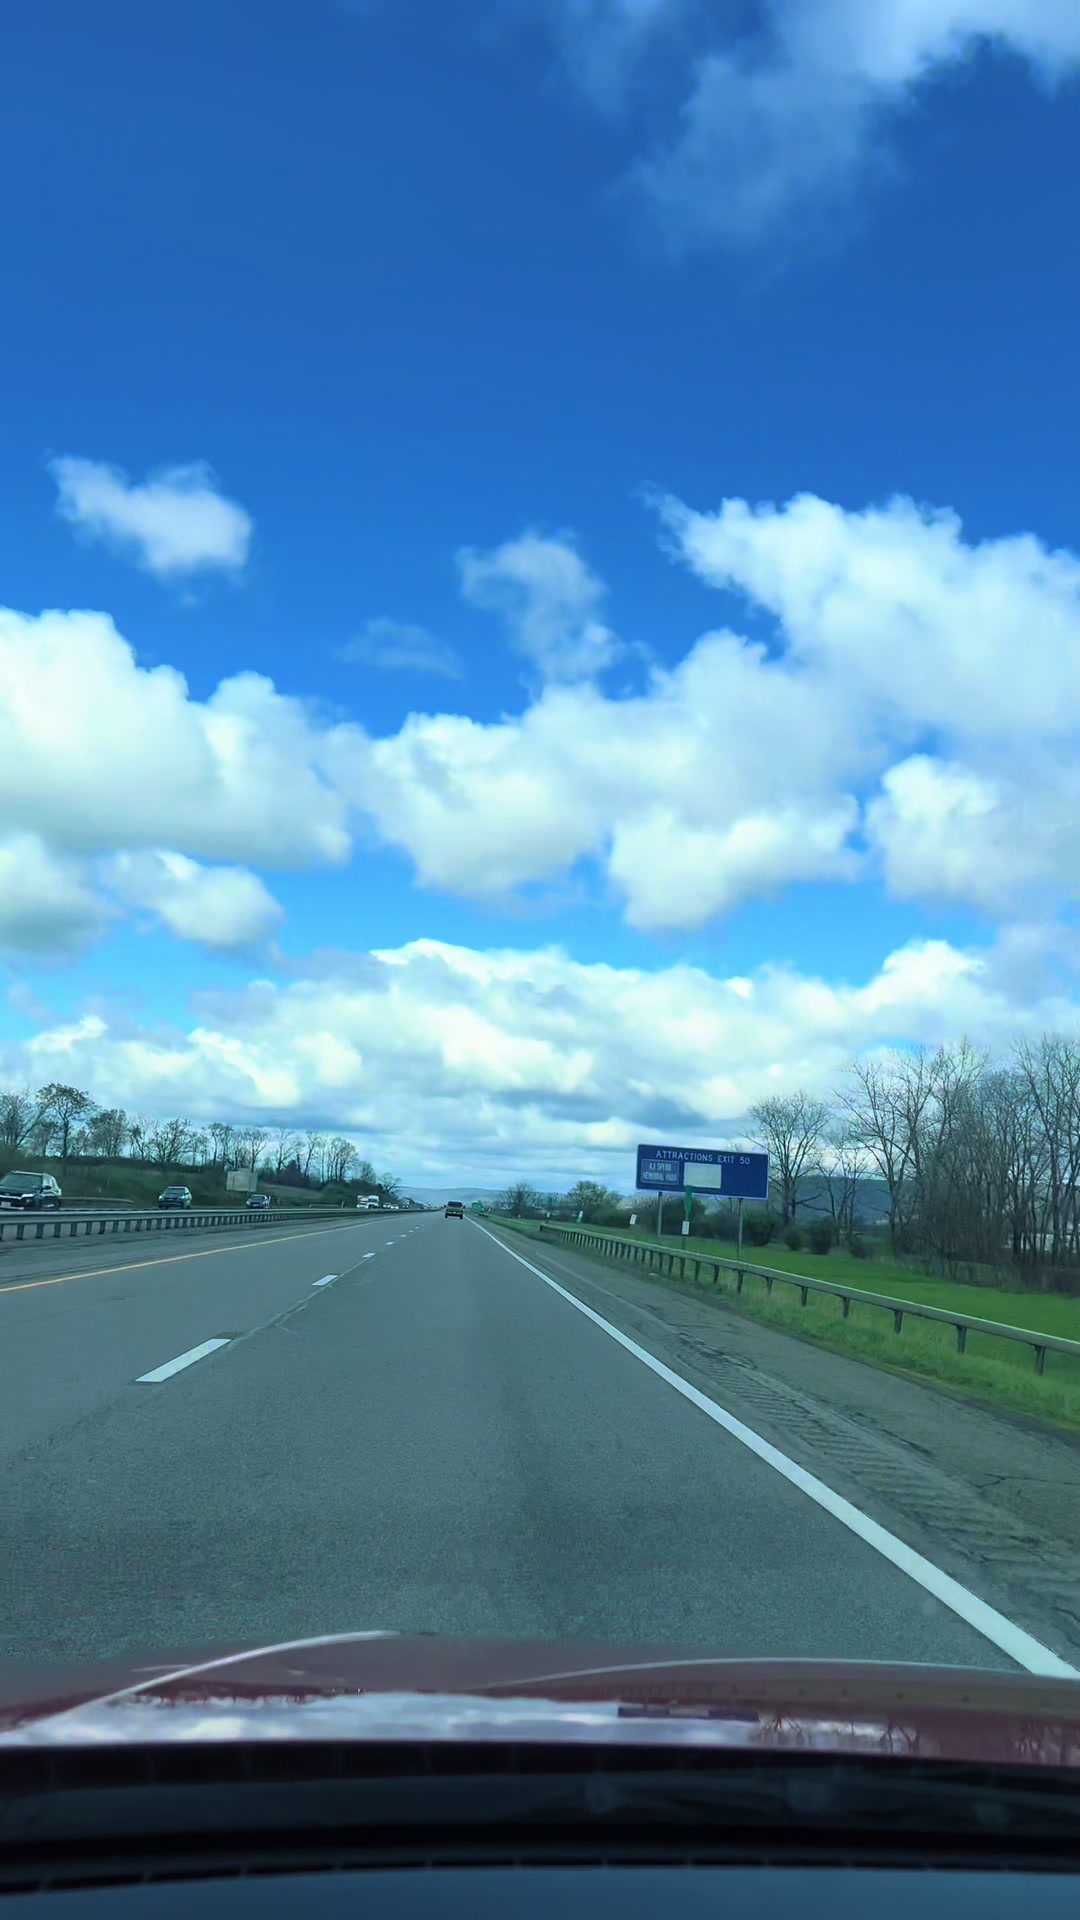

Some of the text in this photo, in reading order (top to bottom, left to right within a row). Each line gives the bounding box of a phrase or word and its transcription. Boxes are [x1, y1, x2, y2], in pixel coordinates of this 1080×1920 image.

[656, 1150, 751, 1165] ATTRACTIONS EXIT 50
